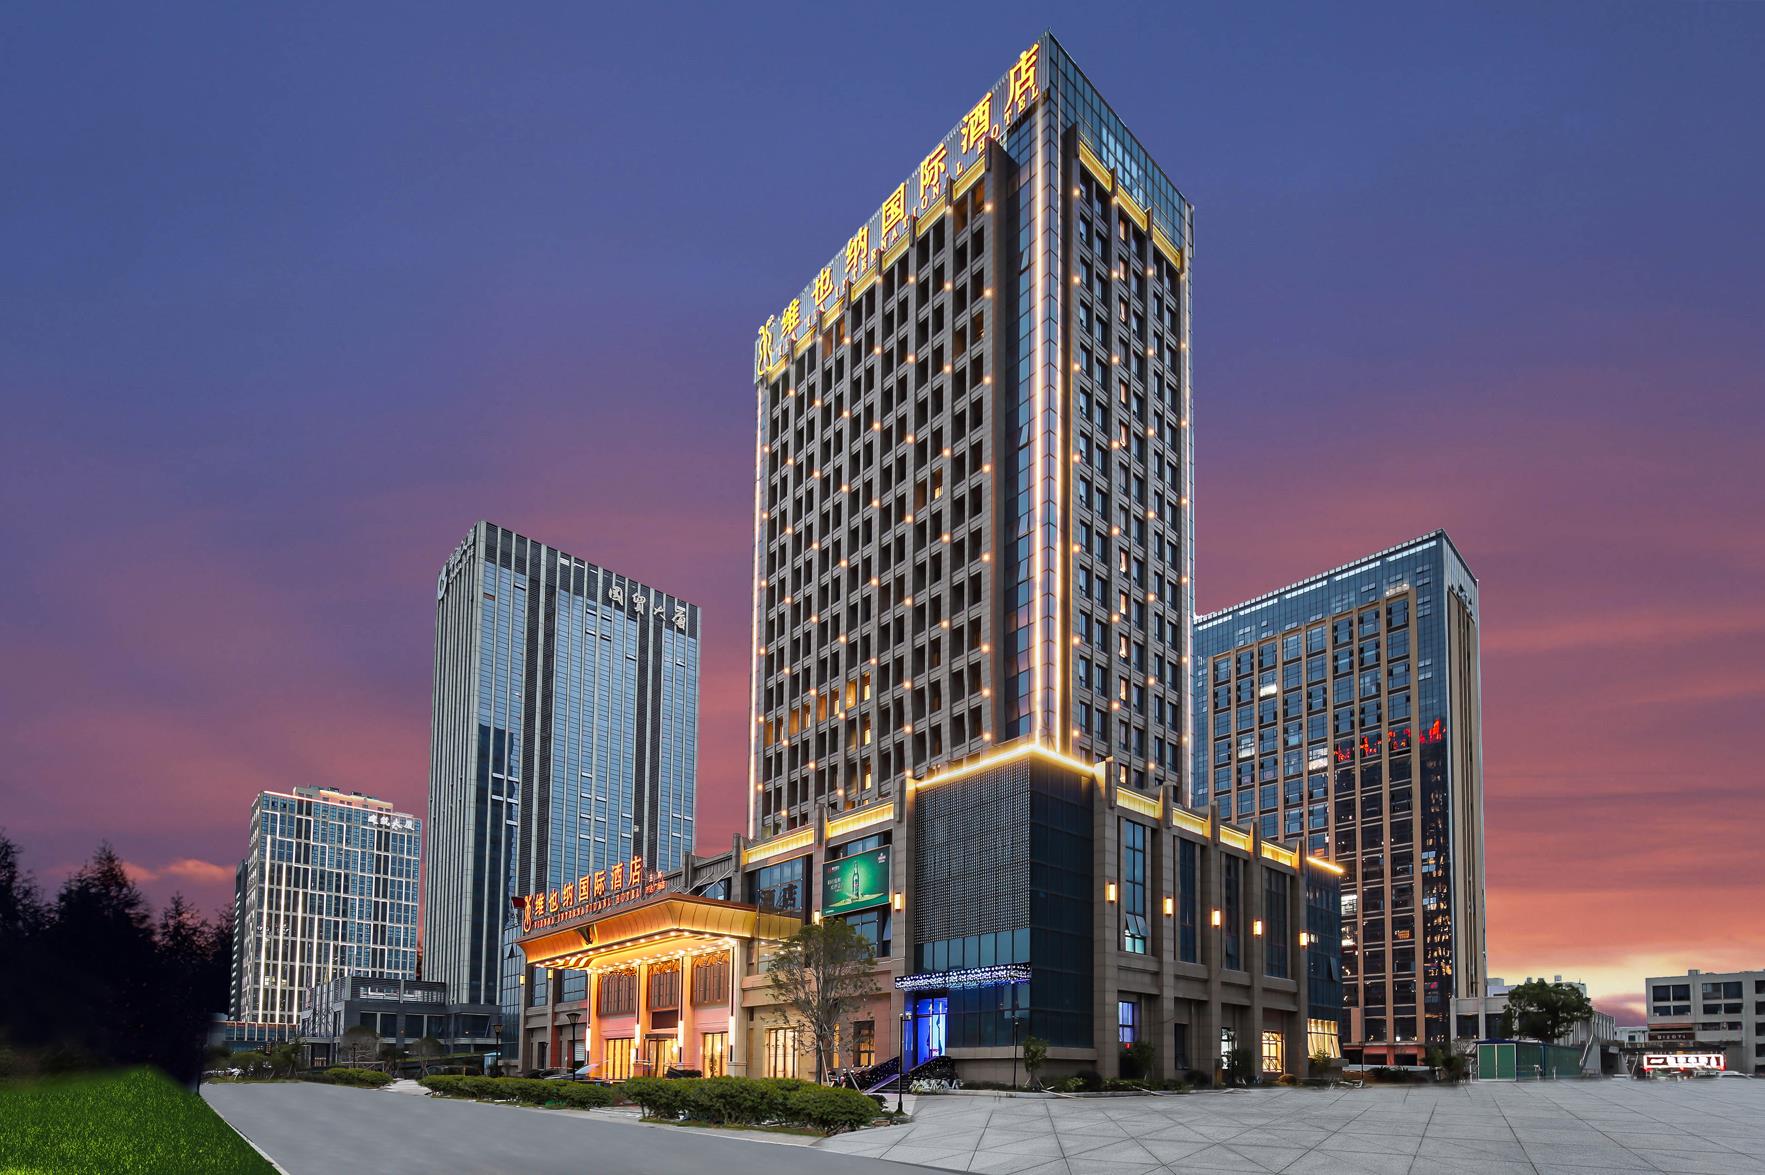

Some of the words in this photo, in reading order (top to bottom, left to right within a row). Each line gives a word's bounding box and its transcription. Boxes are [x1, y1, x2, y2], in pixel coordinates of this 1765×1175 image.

[977, 84, 1040, 155] HOTEL
[781, 43, 1039, 337] 维也纳国际酒店
[534, 856, 643, 917] 维也纳国际酒店
